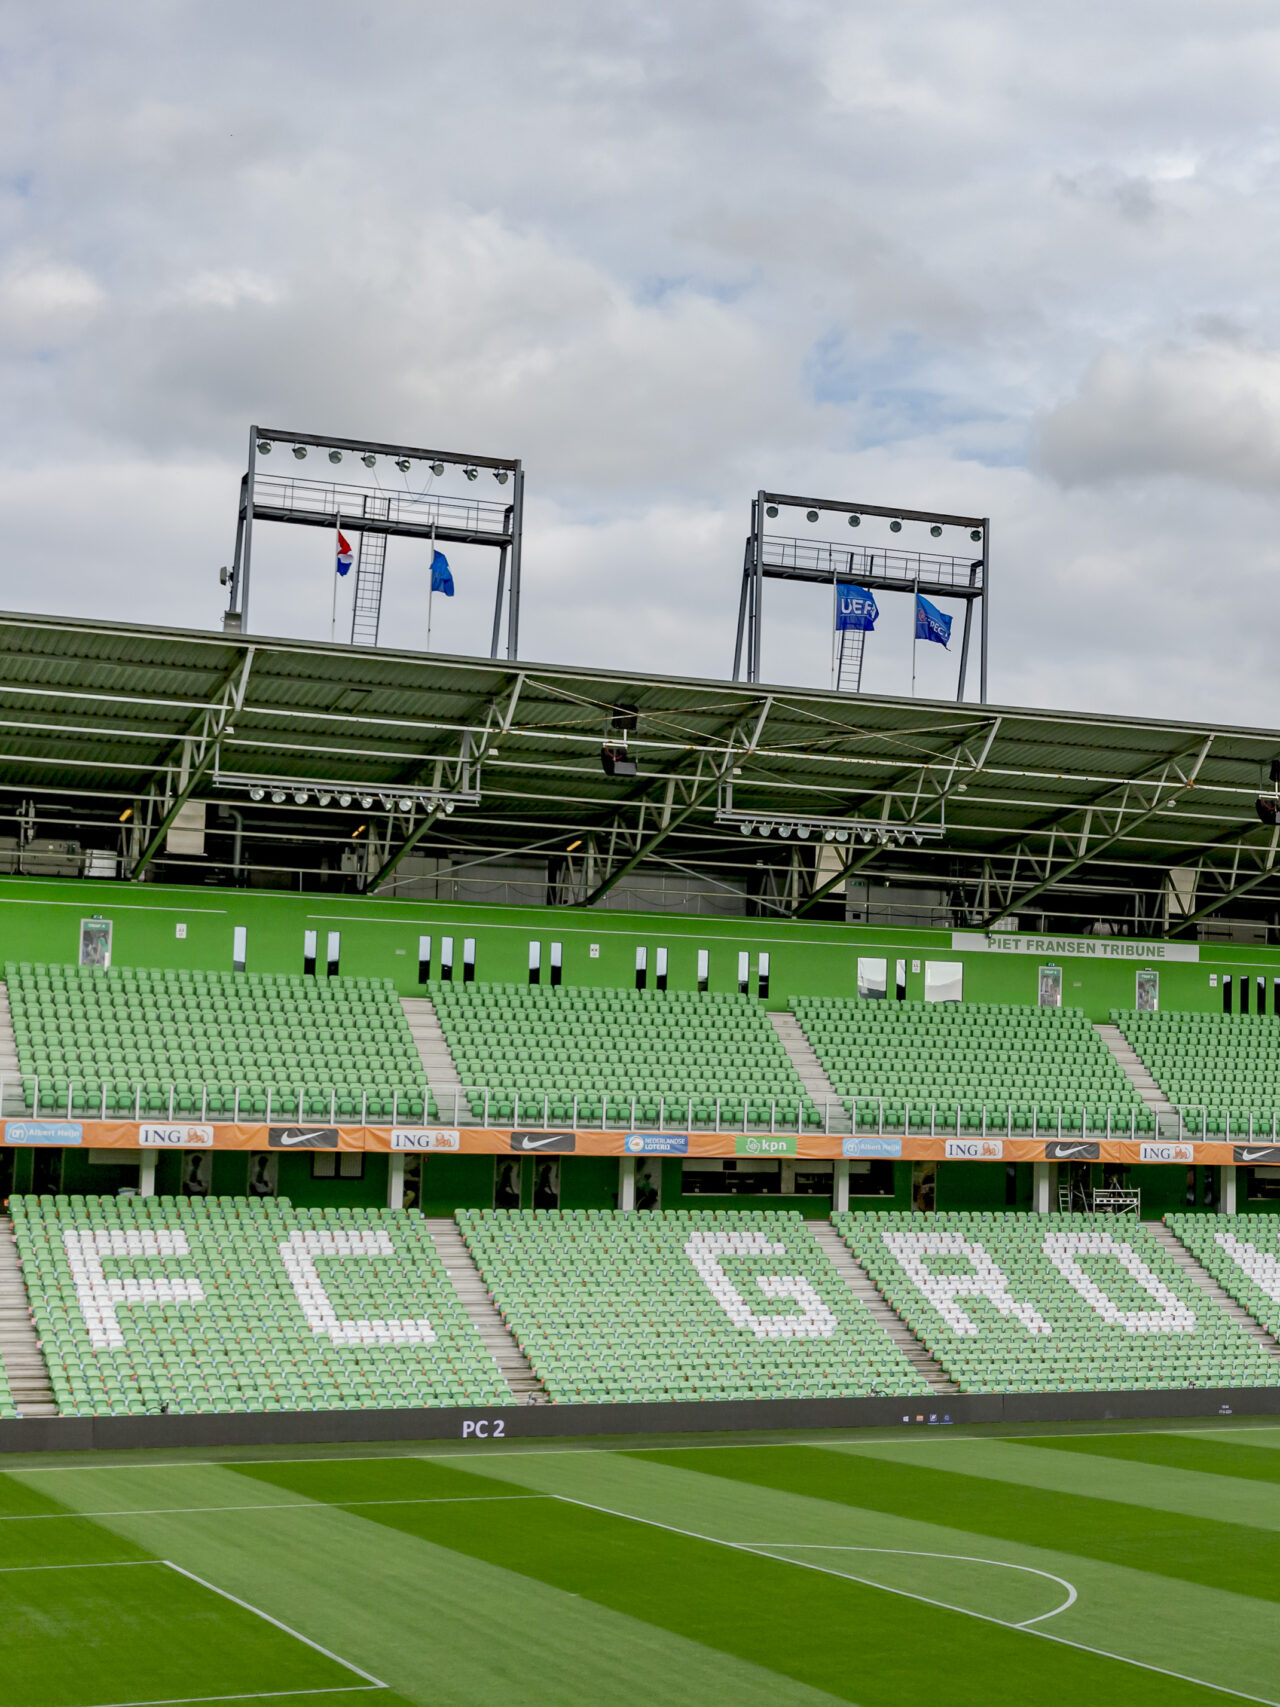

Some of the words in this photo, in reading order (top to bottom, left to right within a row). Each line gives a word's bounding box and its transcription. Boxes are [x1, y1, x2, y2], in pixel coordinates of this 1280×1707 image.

[988, 938, 1022, 950] PIET
[1026, 939, 1096, 954] FRANSEN
[1101, 943, 1166, 958] TRIBUNE
[28, 1129, 55, 1137] Albert
[57, 1130, 80, 1138] Heijn
[144, 1130, 181, 1143] ING
[396, 1134, 430, 1147] ING
[644, 1137, 686, 1145] NEDERLANDSE
[762, 1140, 787, 1151] kpn
[950, 1144, 978, 1156] ING
[1144, 1148, 1171, 1159] ING
[462, 1421, 490, 1438] PC
[492, 1420, 506, 1437] 2
